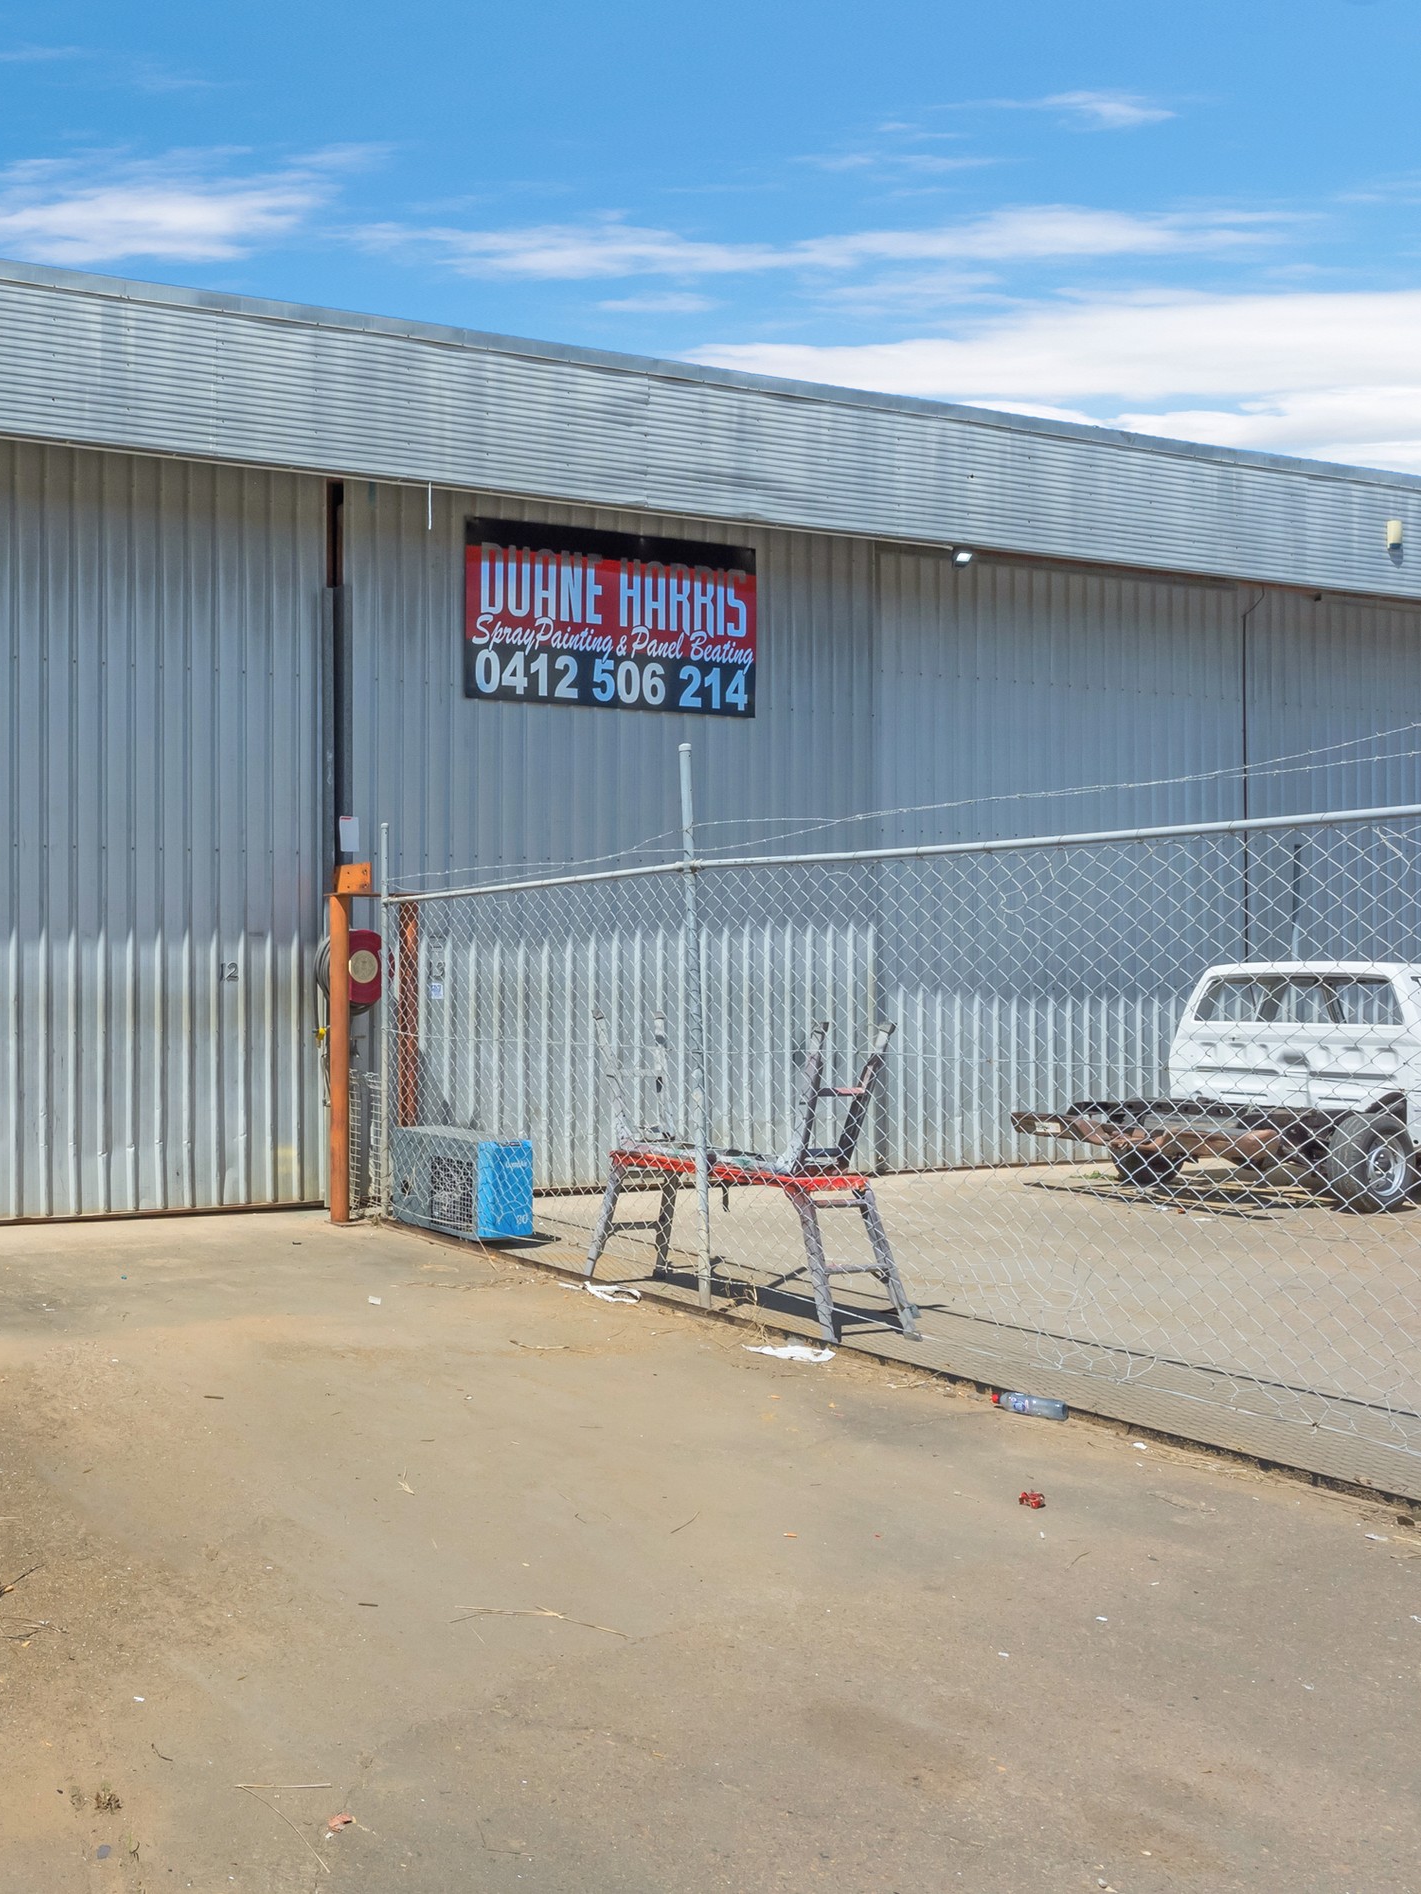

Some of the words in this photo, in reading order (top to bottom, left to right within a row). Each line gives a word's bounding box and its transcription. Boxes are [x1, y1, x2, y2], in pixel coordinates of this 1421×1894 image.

[481, 542, 602, 625] DUANE
[620, 557, 746, 638] HARRIS
[615, 635, 627, 656] &
[631, 626, 683, 659] Panel
[690, 631, 753, 675] Beating
[475, 649, 579, 699] 0412
[593, 658, 666, 705] 506
[679, 665, 748, 711] 214
[220, 962, 239, 982] 12
